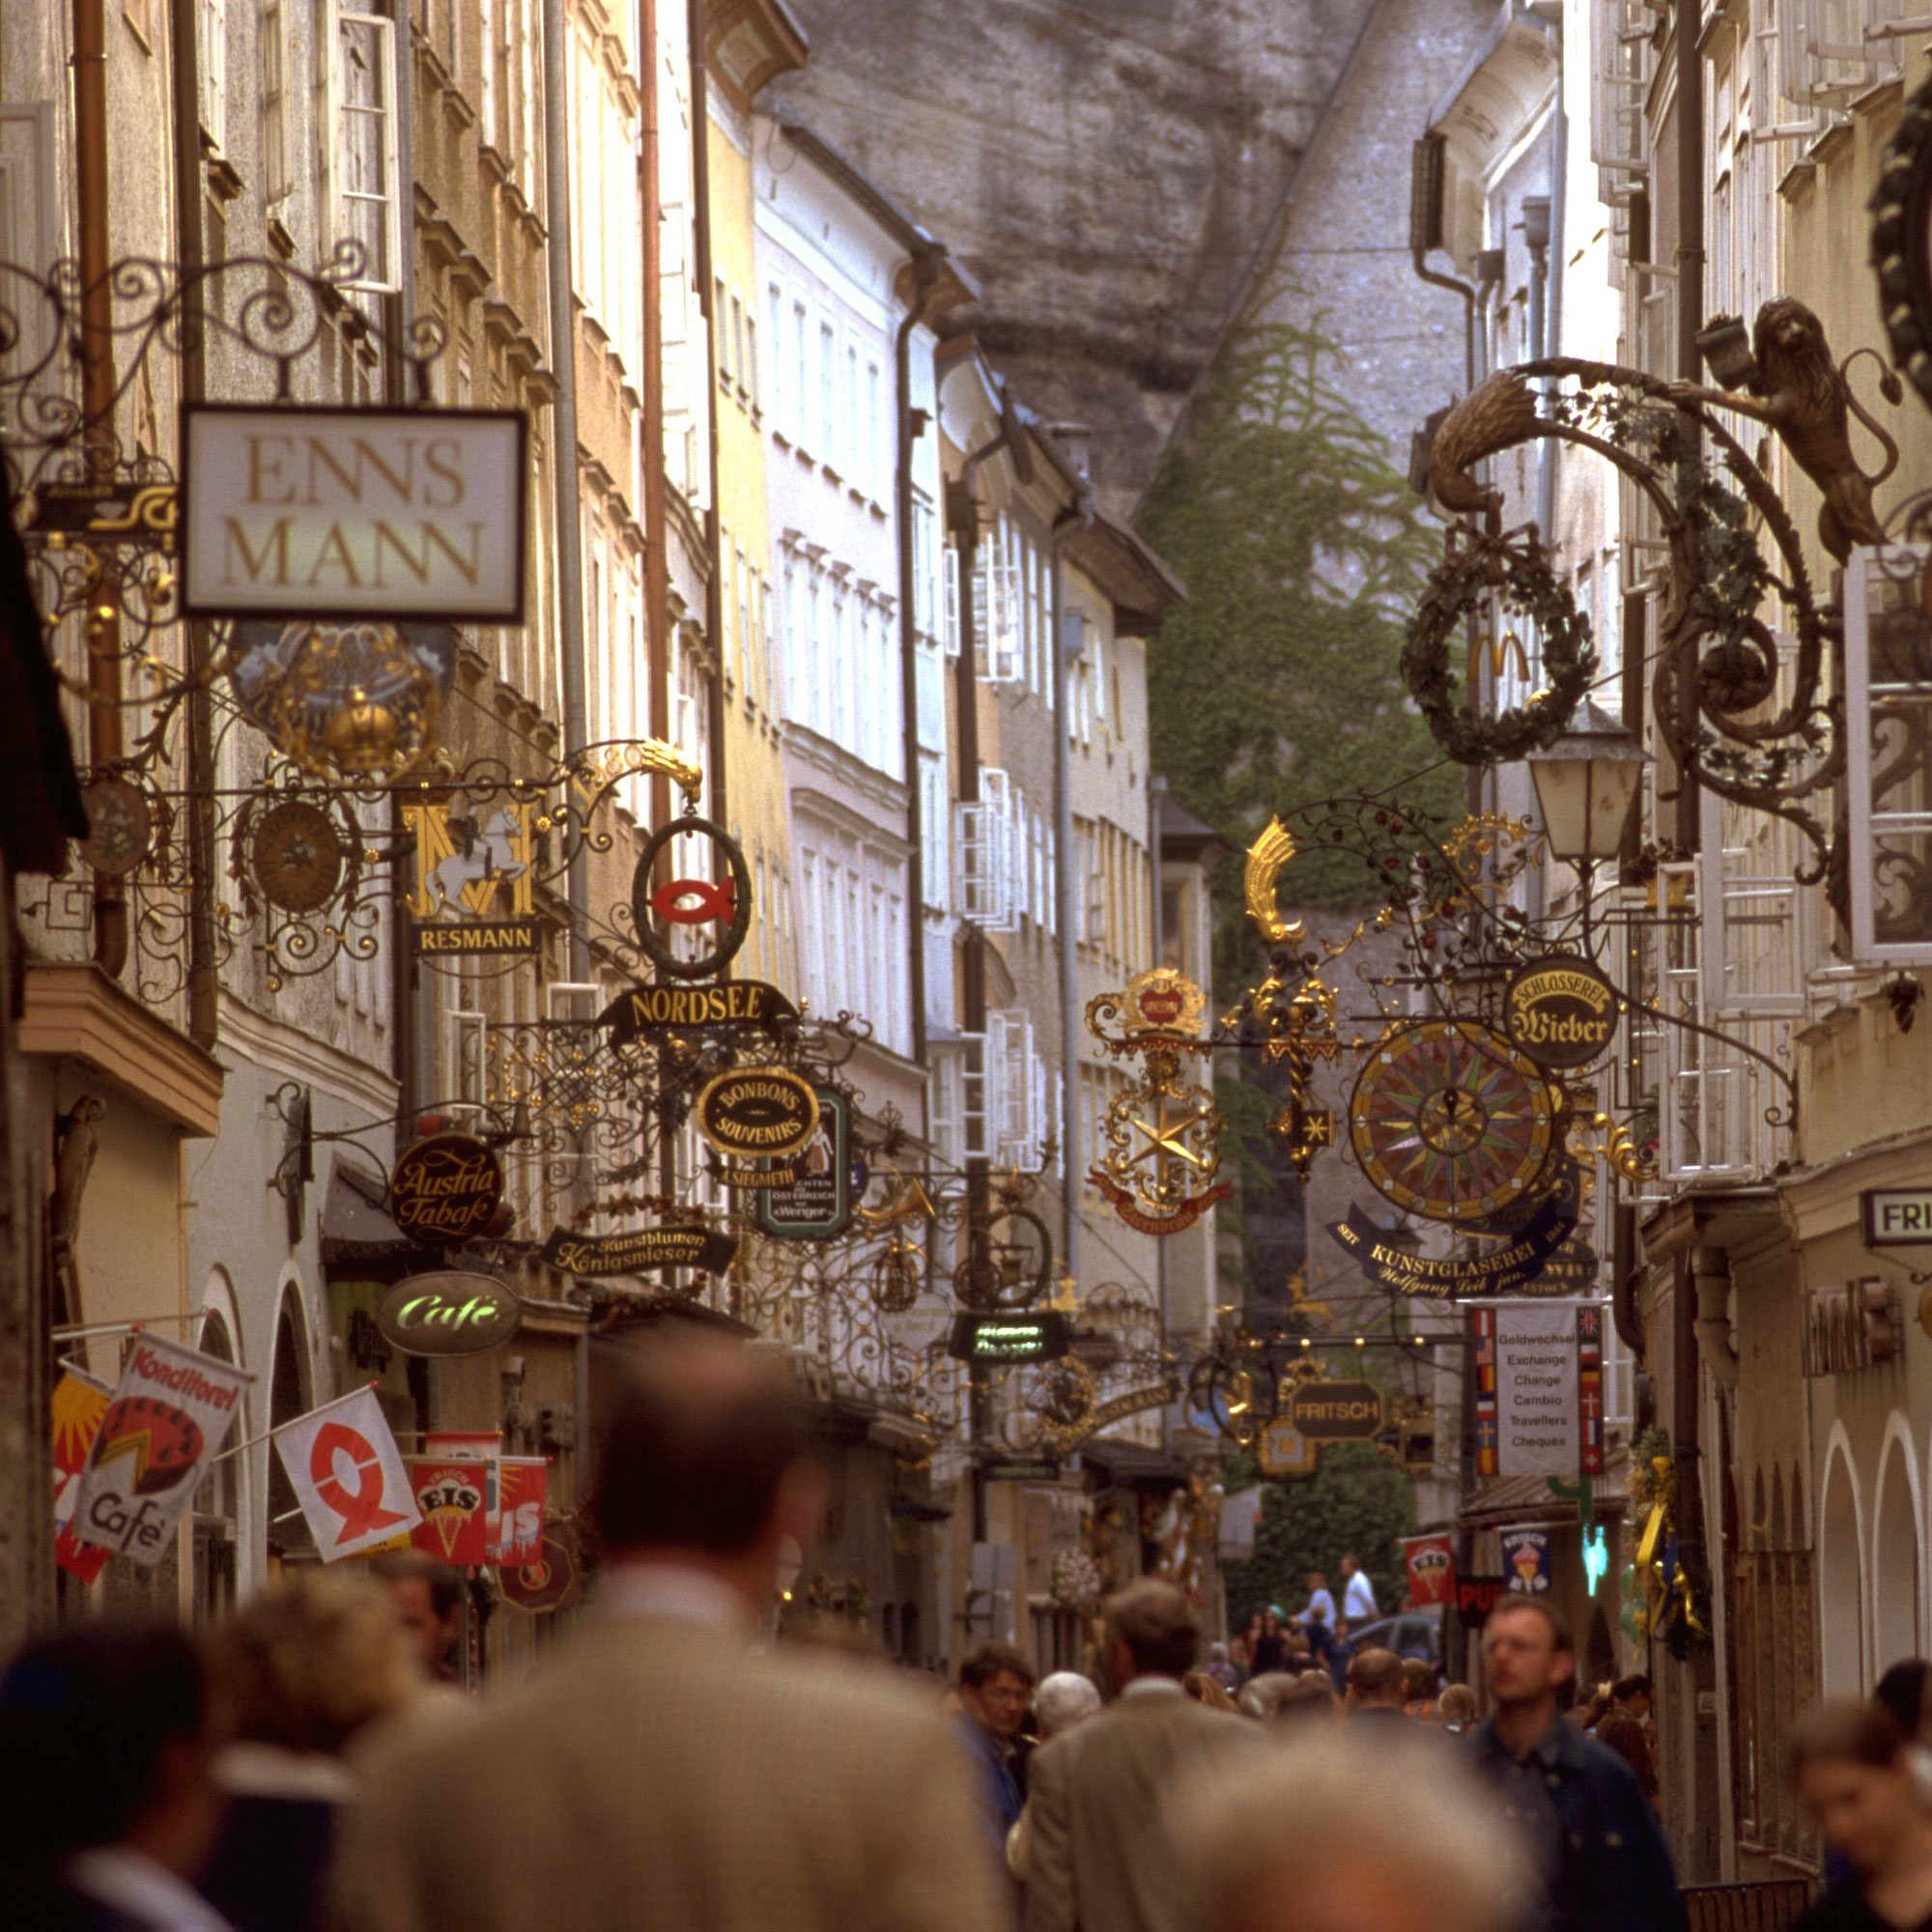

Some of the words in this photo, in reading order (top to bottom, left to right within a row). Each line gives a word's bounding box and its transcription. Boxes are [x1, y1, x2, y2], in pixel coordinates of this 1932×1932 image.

[244, 435, 466, 510] ENNS
[220, 515, 486, 589] MANN
[420, 927, 532, 951] RESMANN
[1516, 974, 1606, 1004] SCHLOSSEREI
[631, 985, 764, 1026] NORDSEE
[1511, 1009, 1608, 1043] Wieber
[720, 1082, 801, 1111] BONBONS
[716, 1118, 803, 1145] SOUVENIRS
[394, 1159, 495, 1197] Austria
[398, 1193, 494, 1229] Tabak
[599, 1232, 706, 1254] Kunstblumen
[1337, 1222, 1360, 1245] SEIT
[1371, 1242, 1536, 1277] KUNSTGLASEREI
[1499, 1333, 1577, 1346] Geldwechsel
[1507, 1355, 1567, 1367] Exchange
[131, 1350, 241, 1411] Konditorei
[1514, 1375, 1561, 1387] Change
[1295, 1402, 1378, 1420] FRITSCH
[1514, 1395, 1562, 1406] Cambio
[1510, 1415, 1567, 1427] Travellers
[1512, 1435, 1566, 1448] Cheques
[419, 1487, 478, 1512] EIS
[89, 1492, 166, 1550] Café
[1503, 1532, 1548, 1548] FRISCH
[1414, 1553, 1447, 1572] EIS
